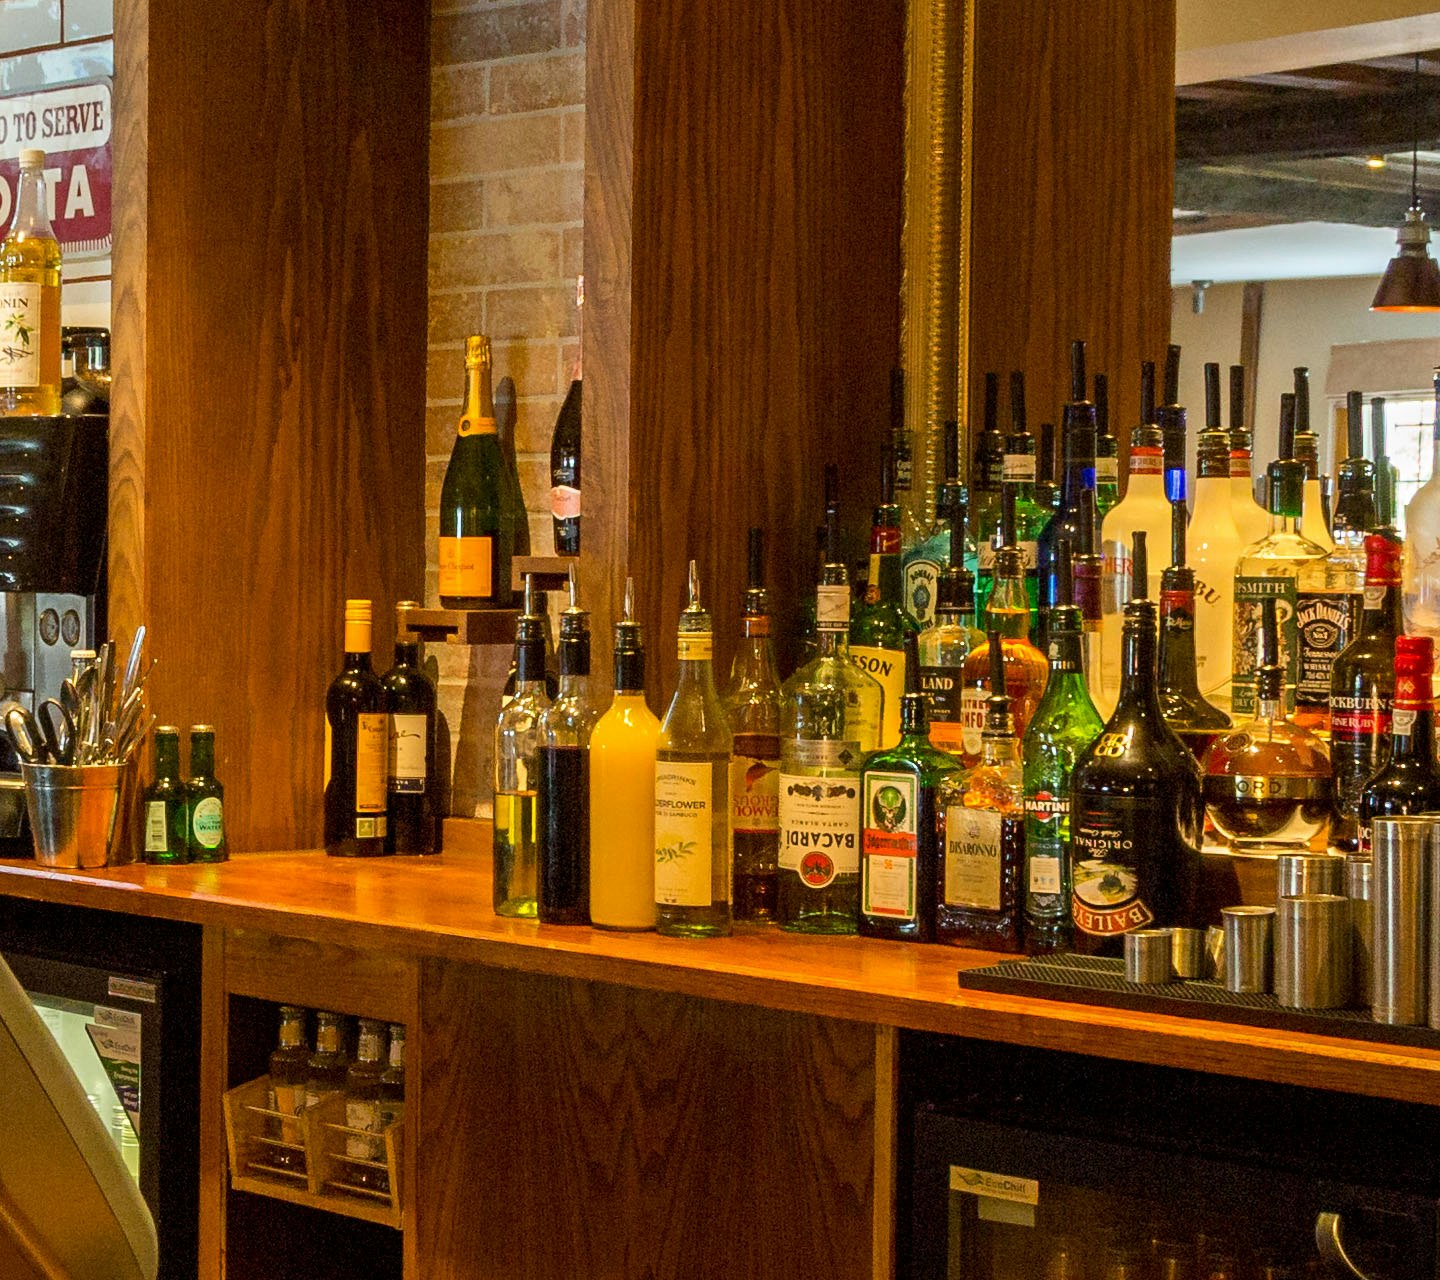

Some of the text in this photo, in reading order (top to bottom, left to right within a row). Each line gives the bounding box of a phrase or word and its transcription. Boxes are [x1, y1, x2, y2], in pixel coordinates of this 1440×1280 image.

[12, 110, 37, 142] TO
[41, 100, 104, 139] SERVE
[1024, 799, 1070, 813] MARTINI
[949, 840, 998, 858] DISARONNO
[1073, 835, 1133, 849] ORIGINAL
